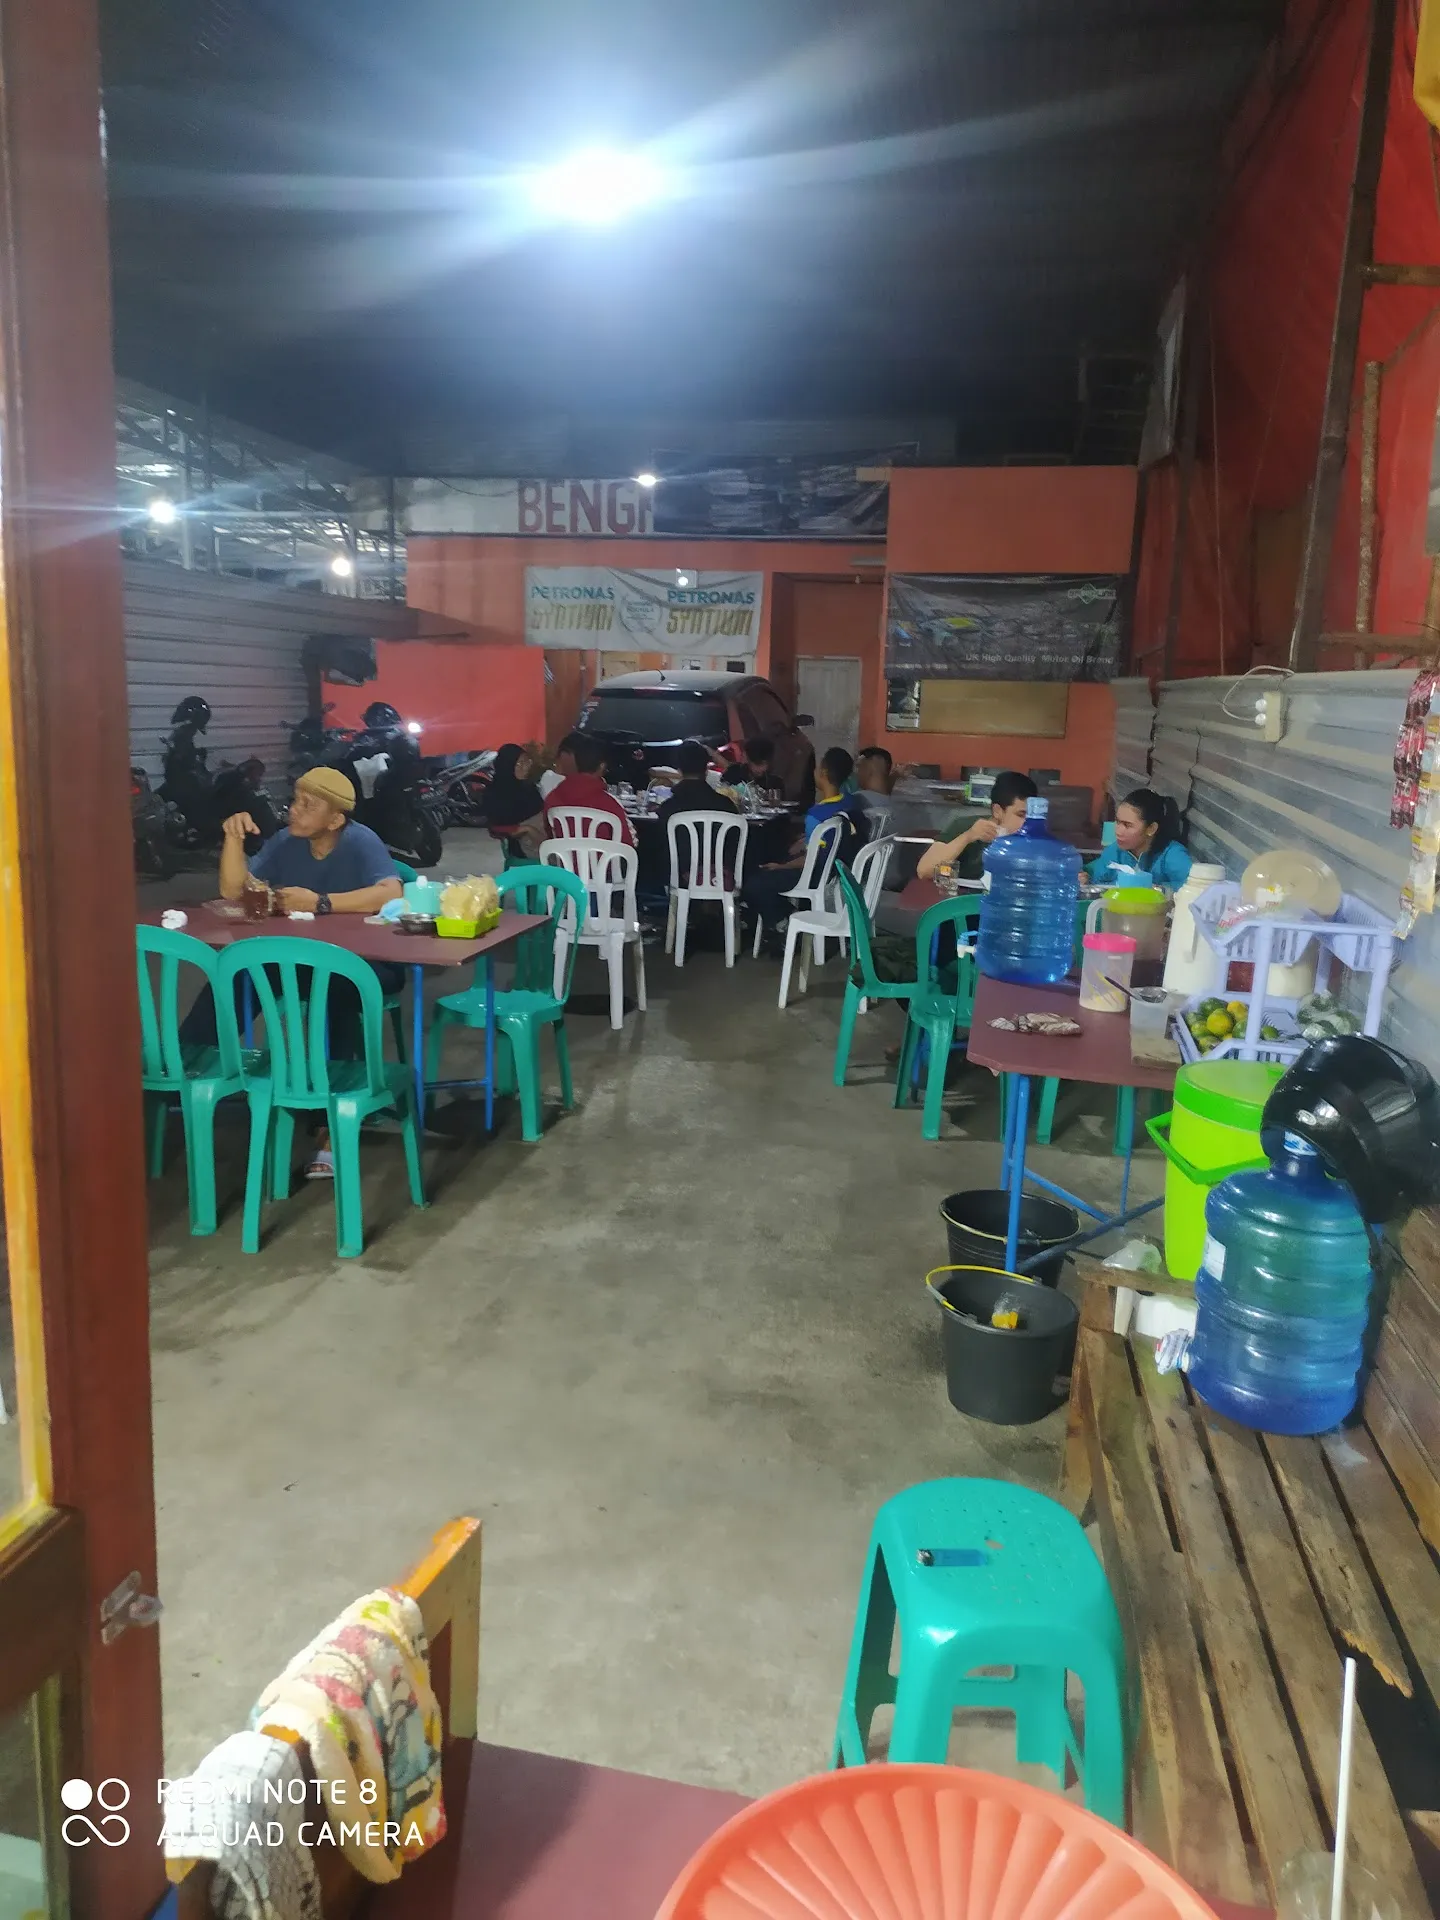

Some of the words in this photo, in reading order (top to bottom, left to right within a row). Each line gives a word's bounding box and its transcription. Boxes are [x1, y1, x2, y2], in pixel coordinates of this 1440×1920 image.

[531, 585, 615, 600] PETRONAS
[667, 590, 755, 605] PETRONAS
[667, 607, 754, 636] SYNTIUM
[982, 653, 1002, 663] High
[1004, 653, 1037, 664] Quality
